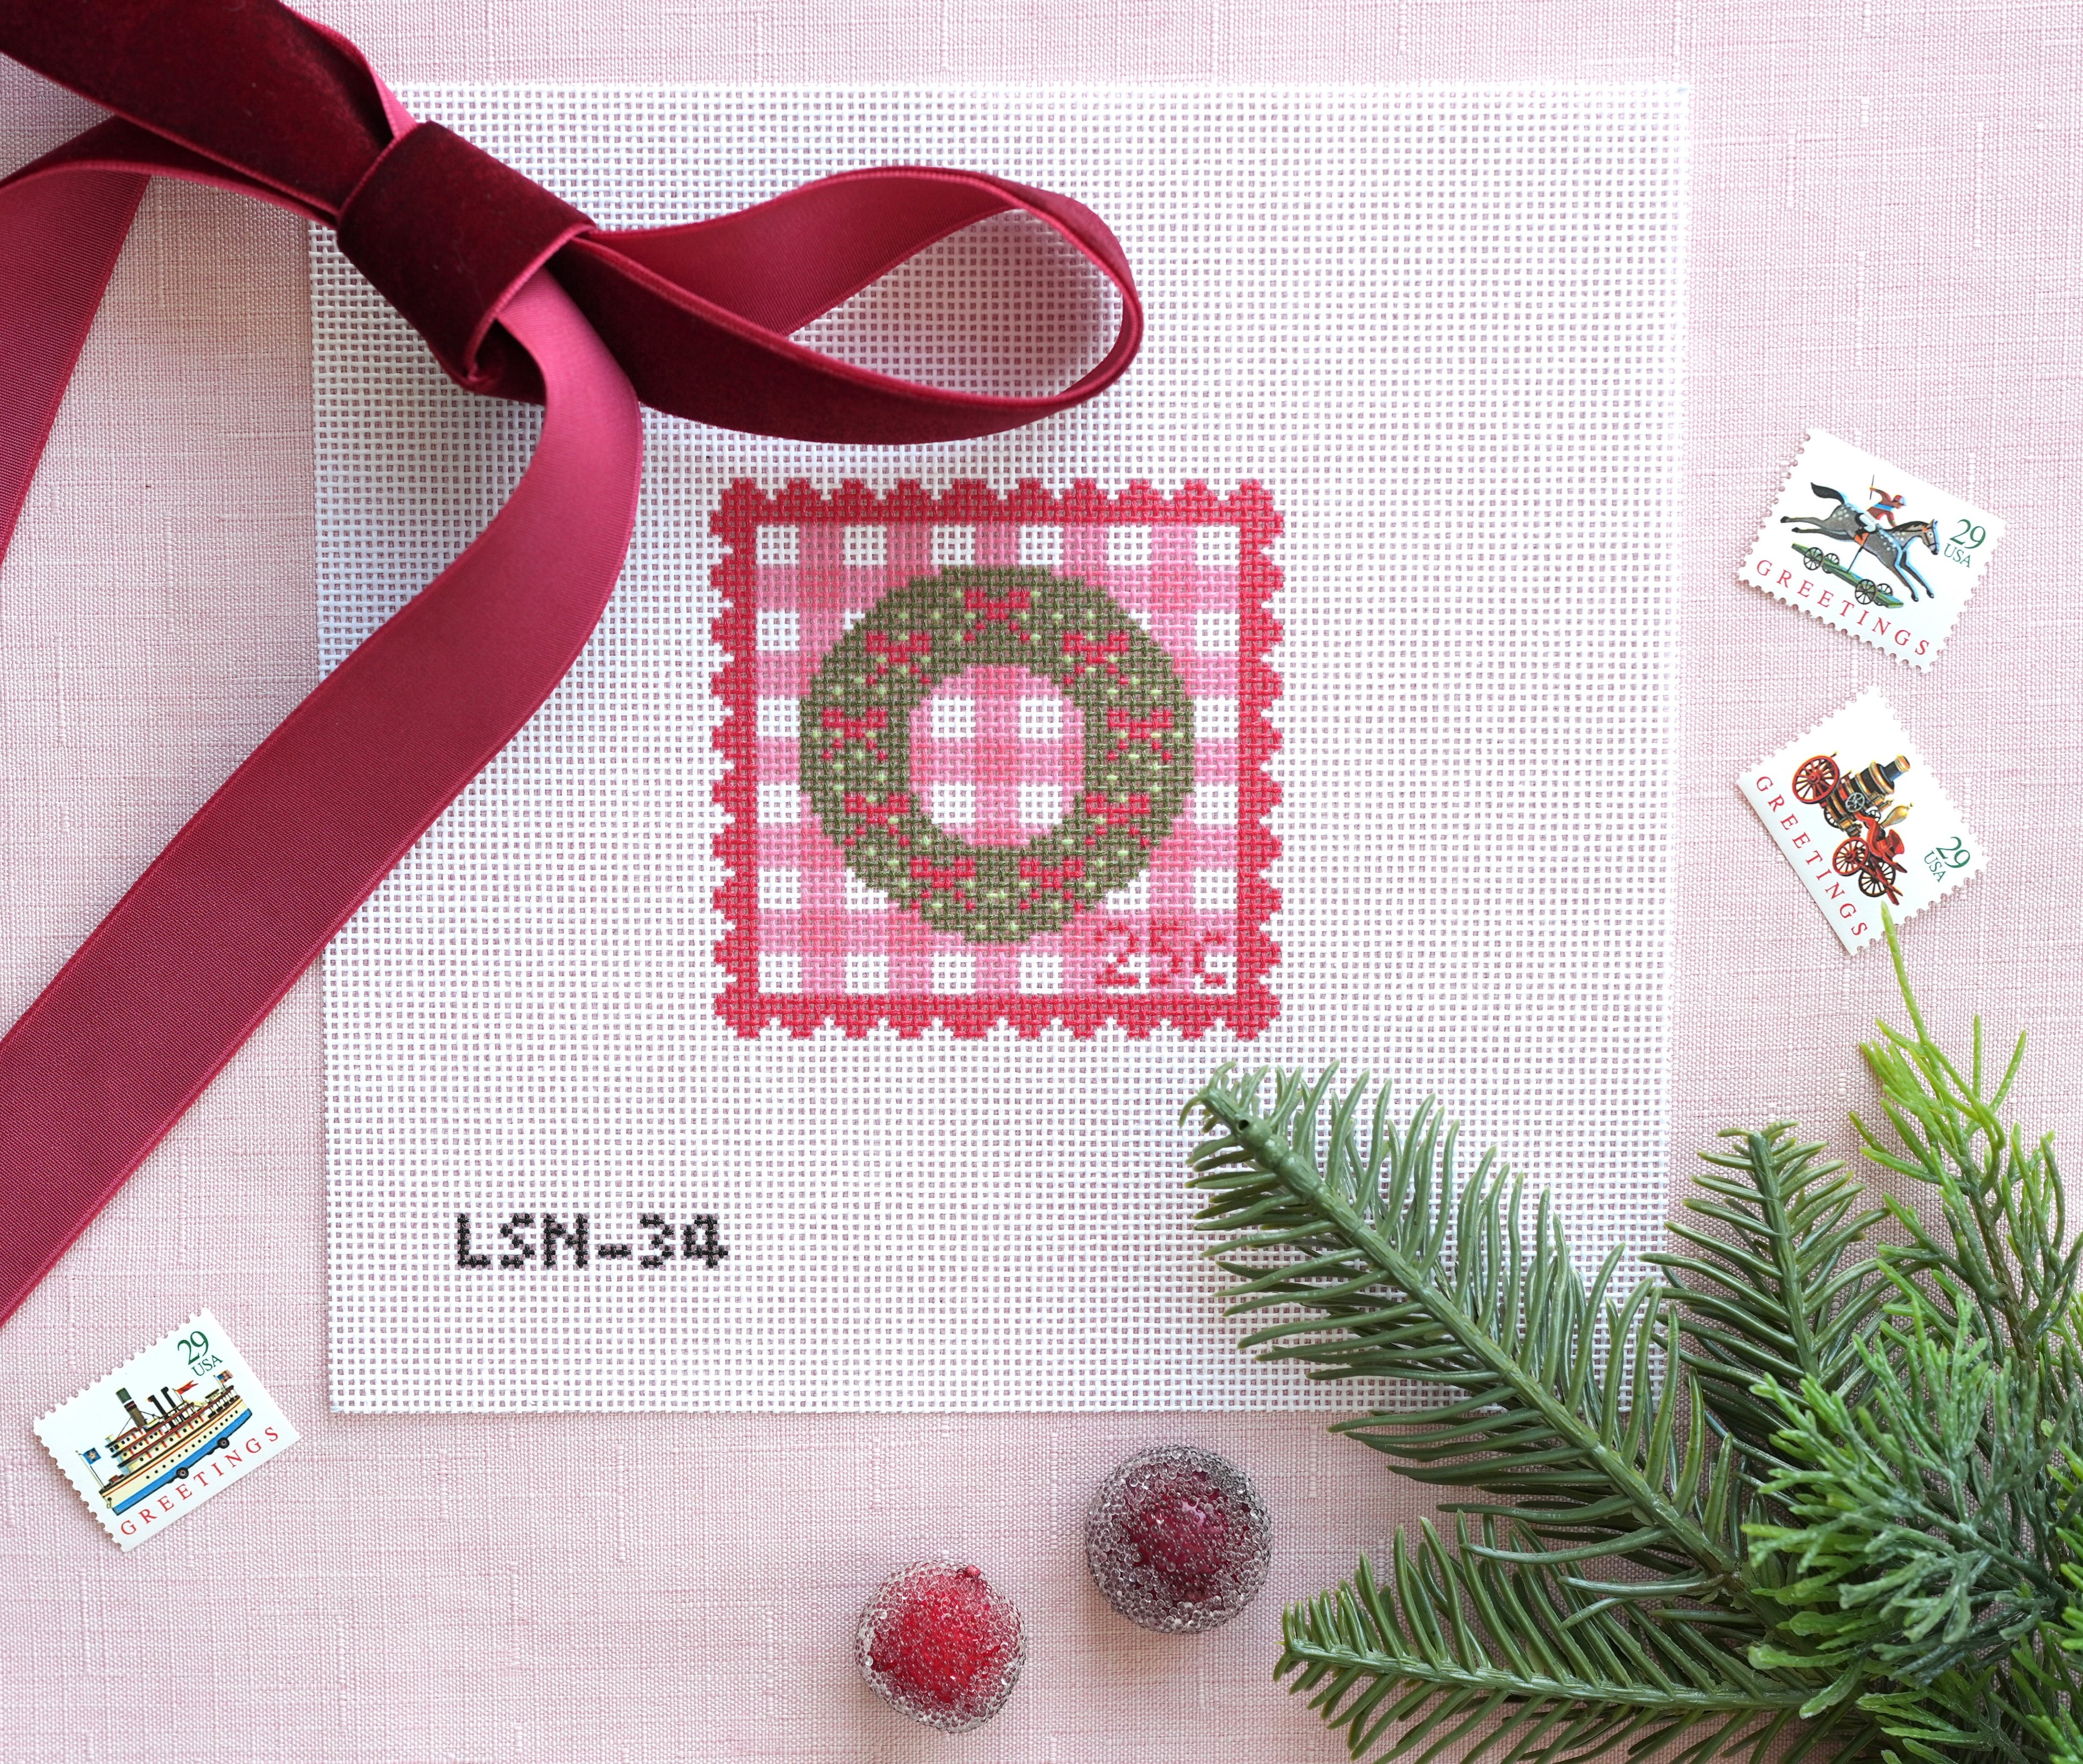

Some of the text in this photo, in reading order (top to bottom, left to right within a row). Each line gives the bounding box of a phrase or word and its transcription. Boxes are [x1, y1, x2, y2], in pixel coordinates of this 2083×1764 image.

[1949, 519, 1986, 549] 29
[1944, 544, 1971, 568] USA
[1756, 560, 1929, 656] GREETINGS
[1756, 776, 1868, 936] GREETINGS
[1924, 851, 1946, 883] USA
[1935, 837, 1970, 868] 29
[457, 1213, 729, 1269] LSN-34
[177, 1331, 209, 1365] 29
[191, 1354, 223, 1376] USA
[120, 1427, 279, 1535] GREETINGS
